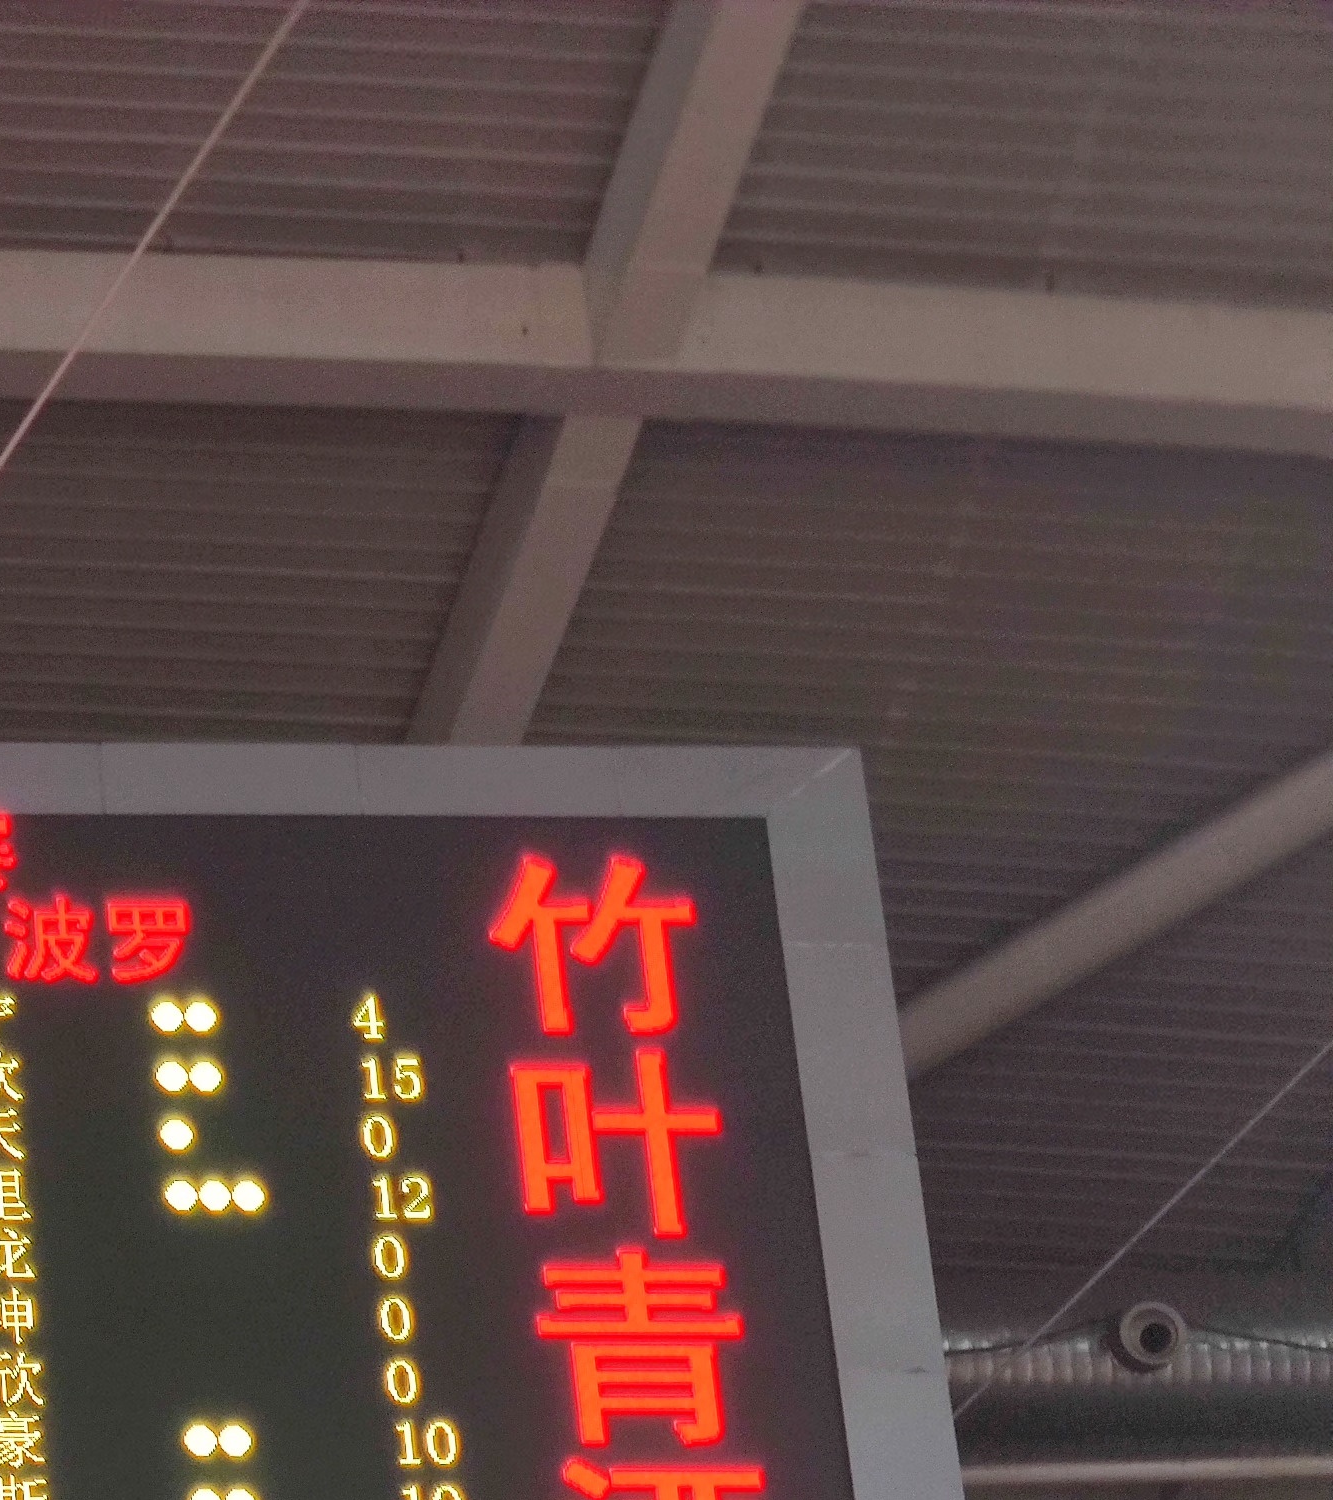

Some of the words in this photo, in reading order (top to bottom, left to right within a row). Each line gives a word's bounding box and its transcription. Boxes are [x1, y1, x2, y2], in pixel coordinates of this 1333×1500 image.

[352, 994, 385, 1041] 4
[360, 1056, 423, 1101] 15
[361, 1114, 395, 1159] 0
[371, 1174, 432, 1221] 12
[372, 1234, 406, 1279] 0
[378, 1296, 412, 1342] 0
[385, 1358, 418, 1405] 0
[394, 1419, 458, 1466] 10
